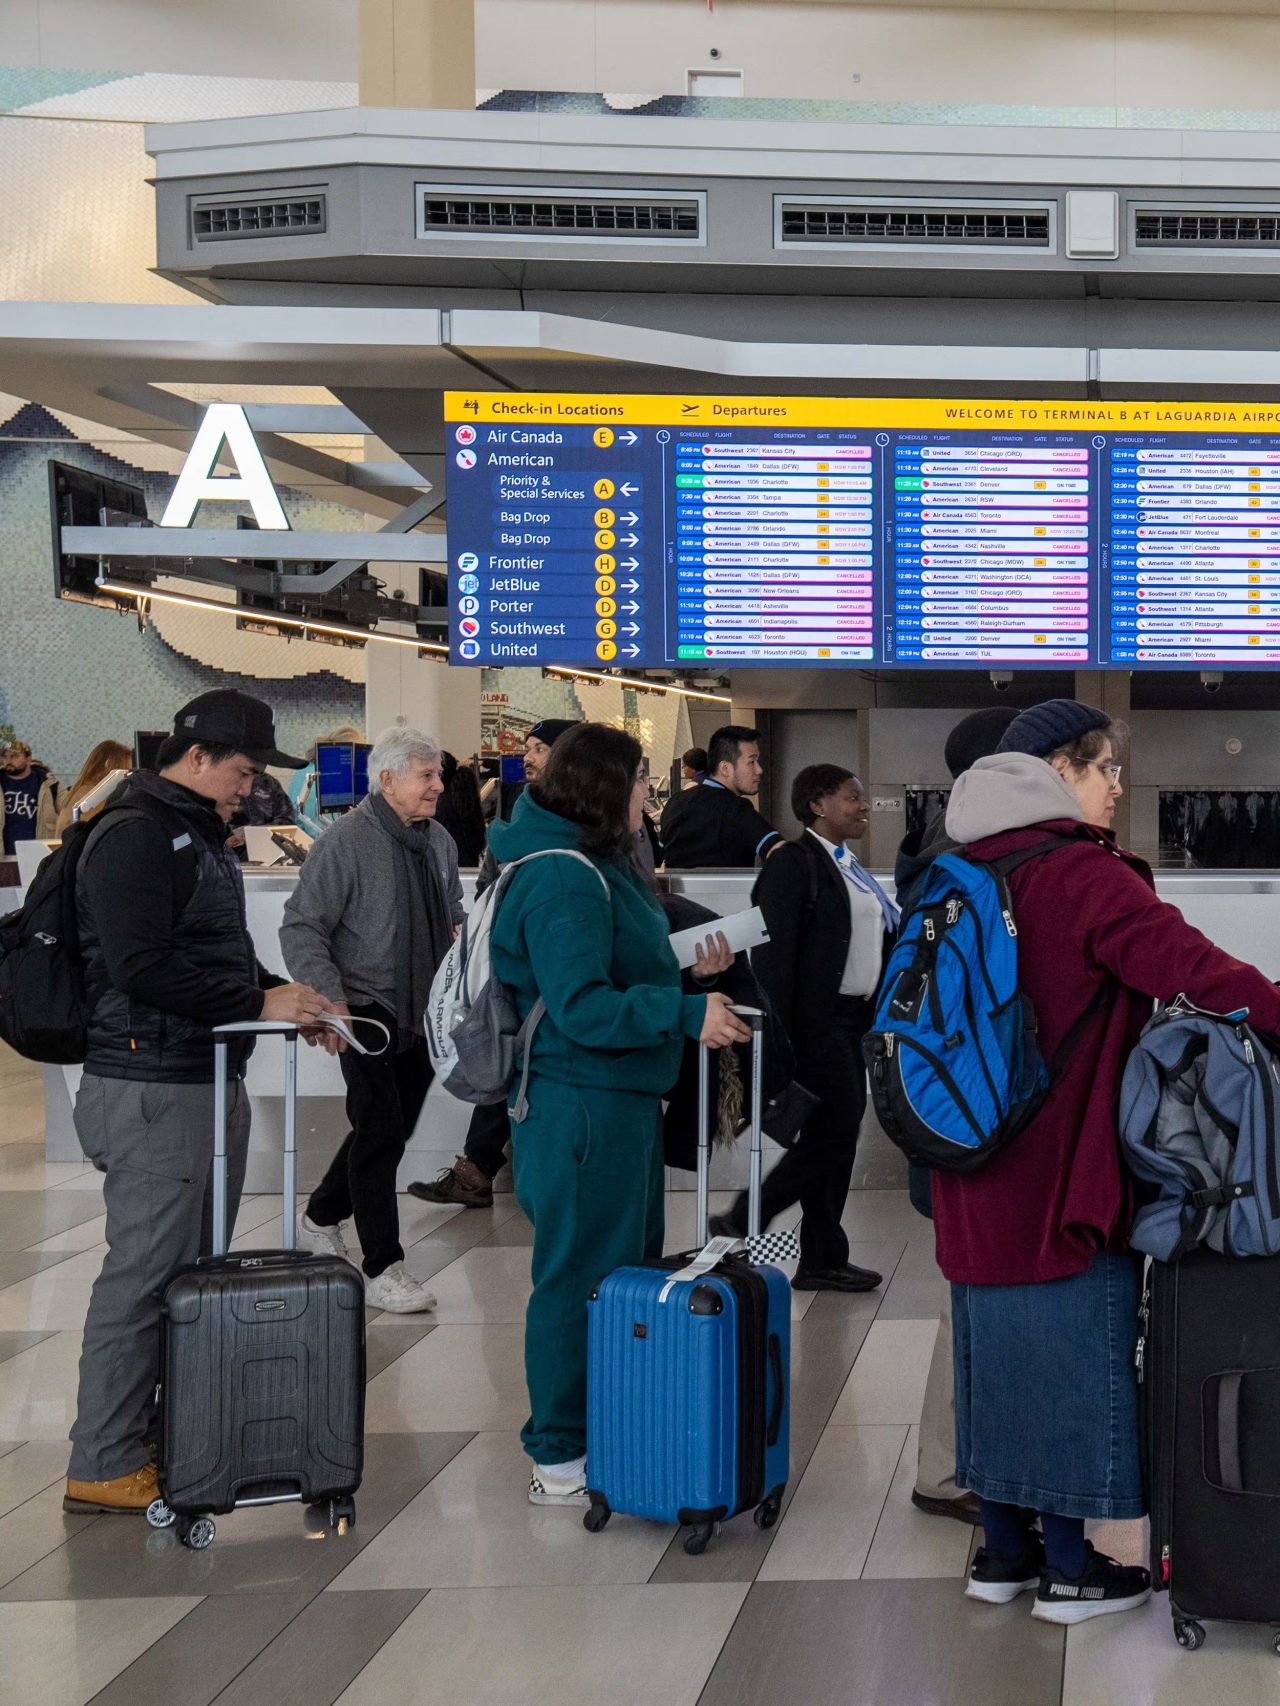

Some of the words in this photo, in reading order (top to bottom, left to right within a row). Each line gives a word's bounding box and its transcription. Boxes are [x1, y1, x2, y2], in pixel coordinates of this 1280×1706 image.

[492, 402, 552, 415] Check-in
[558, 404, 624, 416] Locations
[713, 405, 787, 418] Departures
[945, 409, 1014, 420] WELCOME
[1020, 409, 1038, 420] TO
[1044, 409, 1114, 421] TERMINAL
[1120, 410, 1128, 421] B
[1133, 410, 1151, 421] AT
[1156, 410, 1237, 422] LAGUARDIA
[487, 430, 507, 443] Air
[511, 431, 563, 444] Canada
[599, 432, 607, 443] E
[488, 453, 554, 467] American
[161, 403, 289, 530] A
[500, 475, 539, 486] Priority
[542, 476, 551, 486] &
[500, 488, 538, 500] Special
[541, 489, 585, 500] Services
[599, 483, 609, 495] A
[501, 512, 521, 525] Bag
[524, 512, 550, 524] Drop
[600, 513, 609, 524] B
[501, 534, 521, 545] Bag
[524, 534, 550, 546] Drop
[599, 533, 608, 545] C
[489, 556, 544, 570] Frontier
[600, 559, 609, 569] H
[489, 579, 540, 591] JetBlue
[601, 580, 611, 591] D
[490, 600, 534, 613] Porter
[602, 602, 611, 613] D
[490, 621, 566, 635] Southwest
[601, 623, 611, 634] G
[490, 643, 538, 656] United
[602, 645, 609, 655] F
[1050, 1583, 1079, 1597] PUMA
